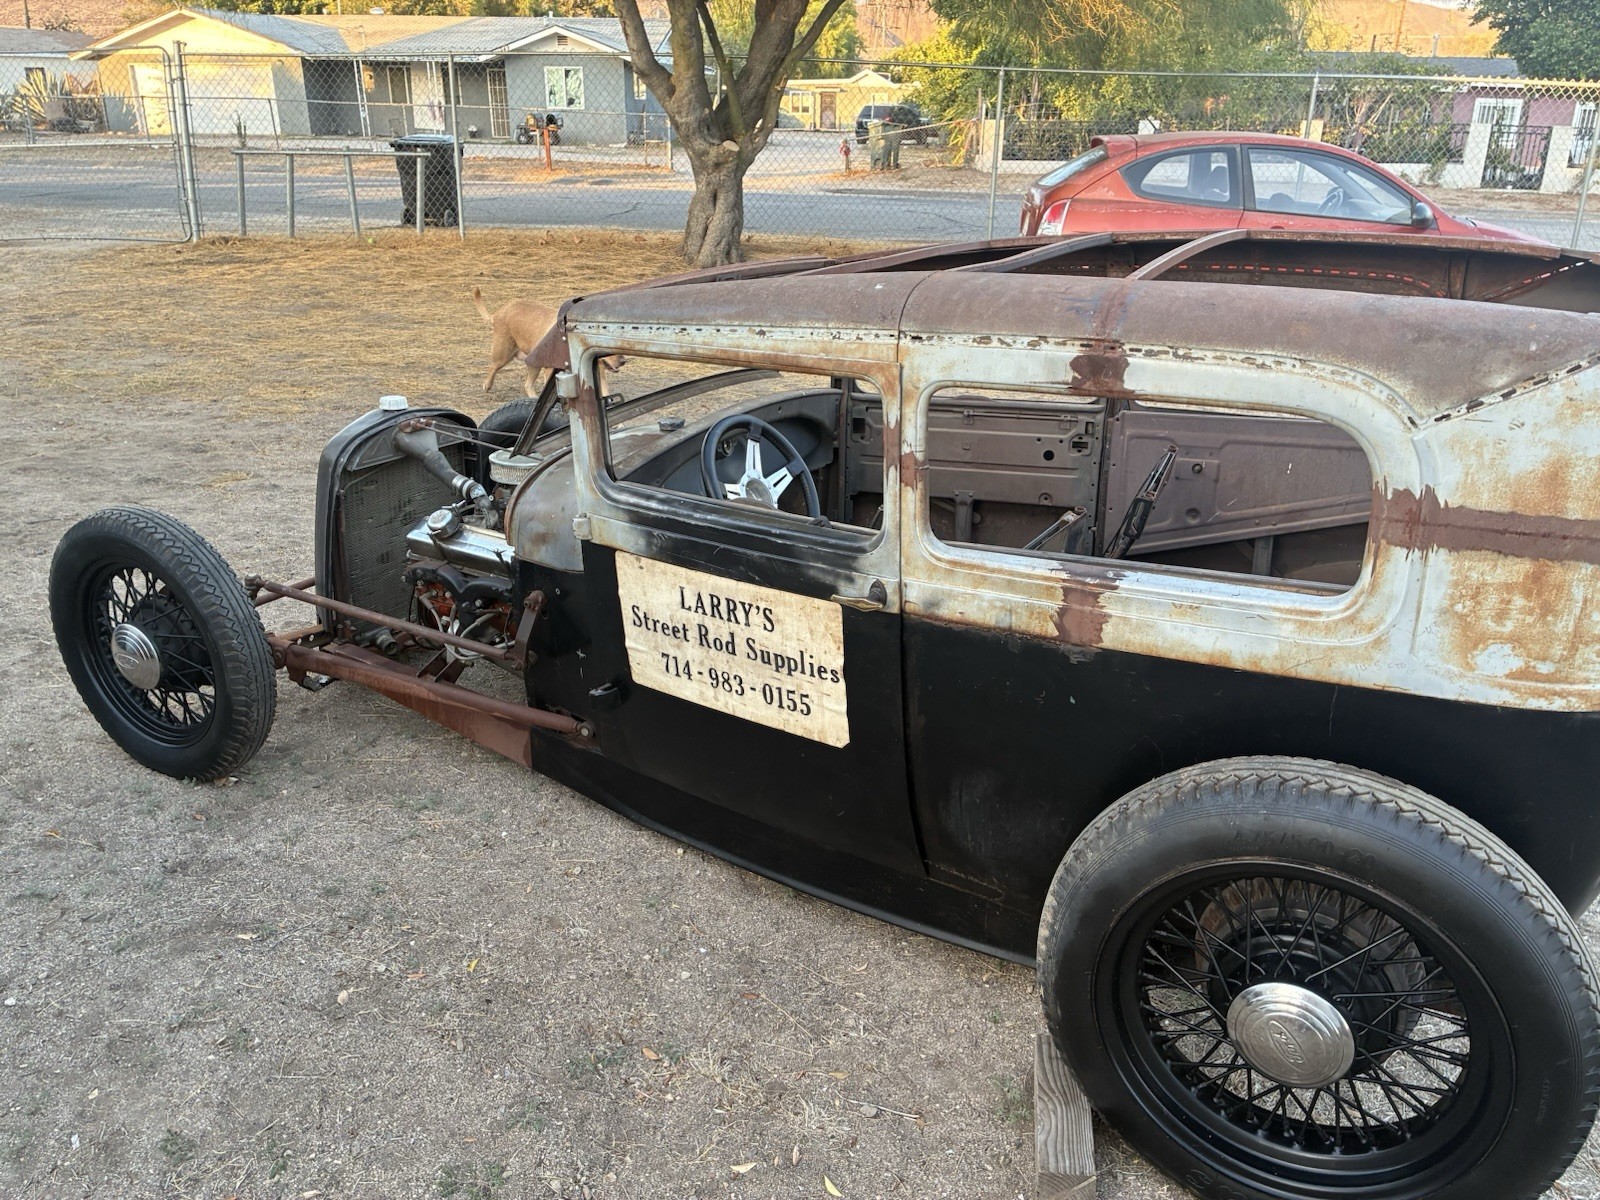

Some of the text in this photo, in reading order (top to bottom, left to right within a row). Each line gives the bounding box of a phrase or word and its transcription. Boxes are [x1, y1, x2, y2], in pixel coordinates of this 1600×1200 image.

[679, 586, 775, 633] LARRY'S
[631, 605, 841, 683] Street Rod Supplies
